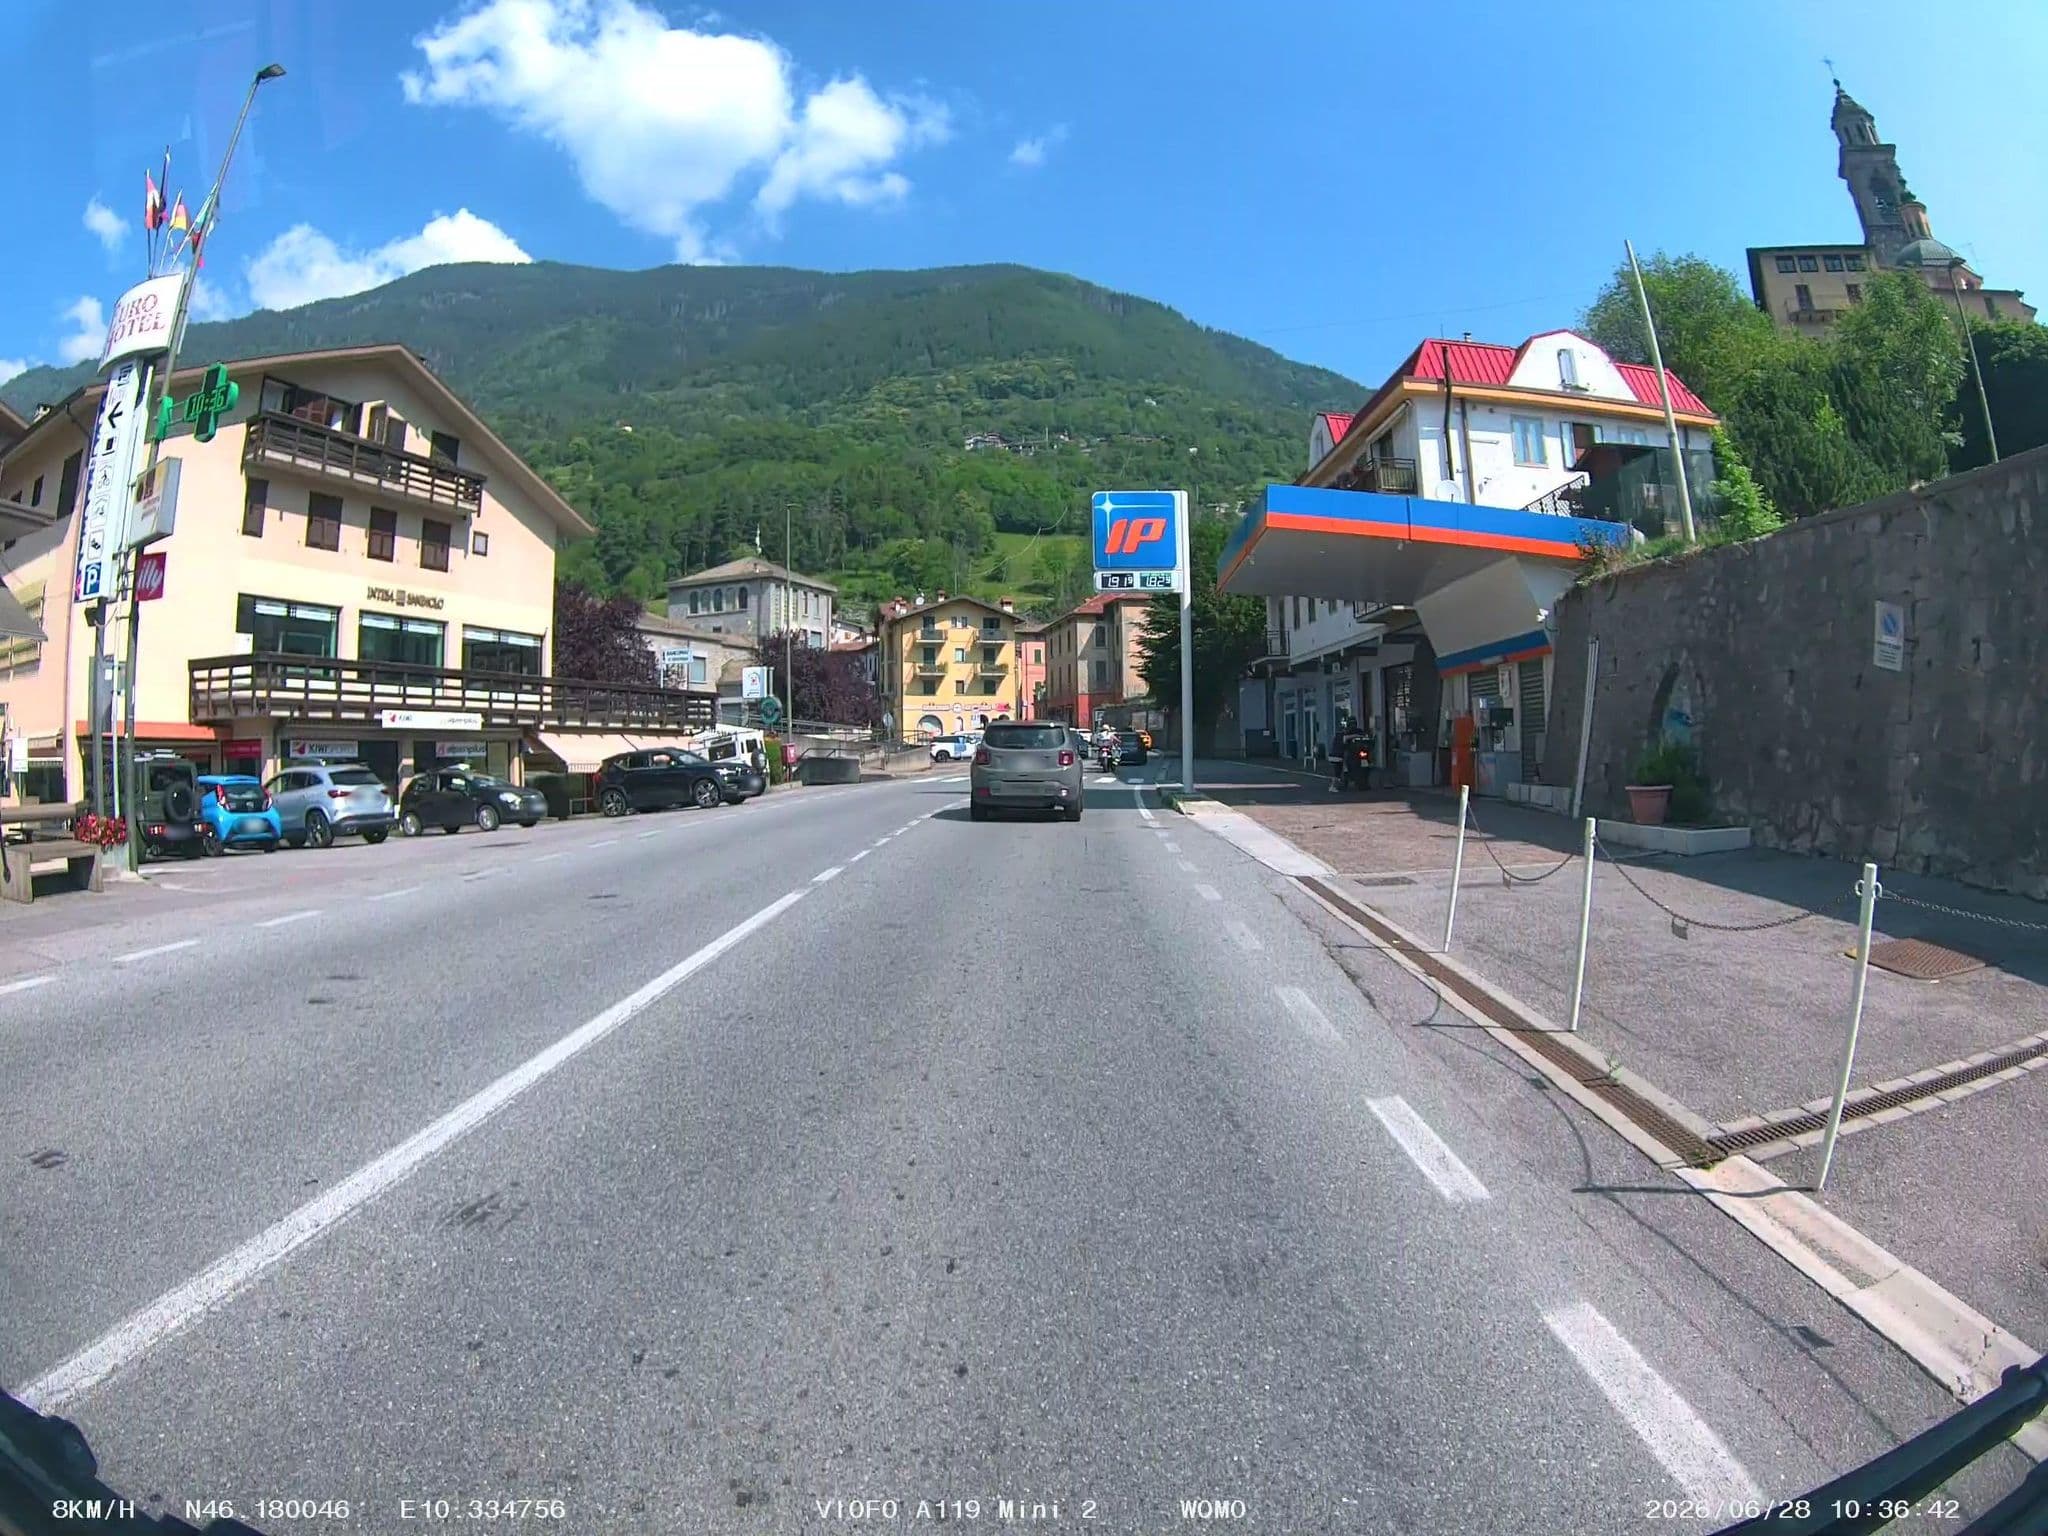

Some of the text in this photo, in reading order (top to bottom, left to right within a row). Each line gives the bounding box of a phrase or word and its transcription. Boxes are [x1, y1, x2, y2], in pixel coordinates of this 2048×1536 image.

[191, 387, 225, 417] 10:36
[1104, 518, 1168, 555] IP
[137, 559, 163, 597] illy
